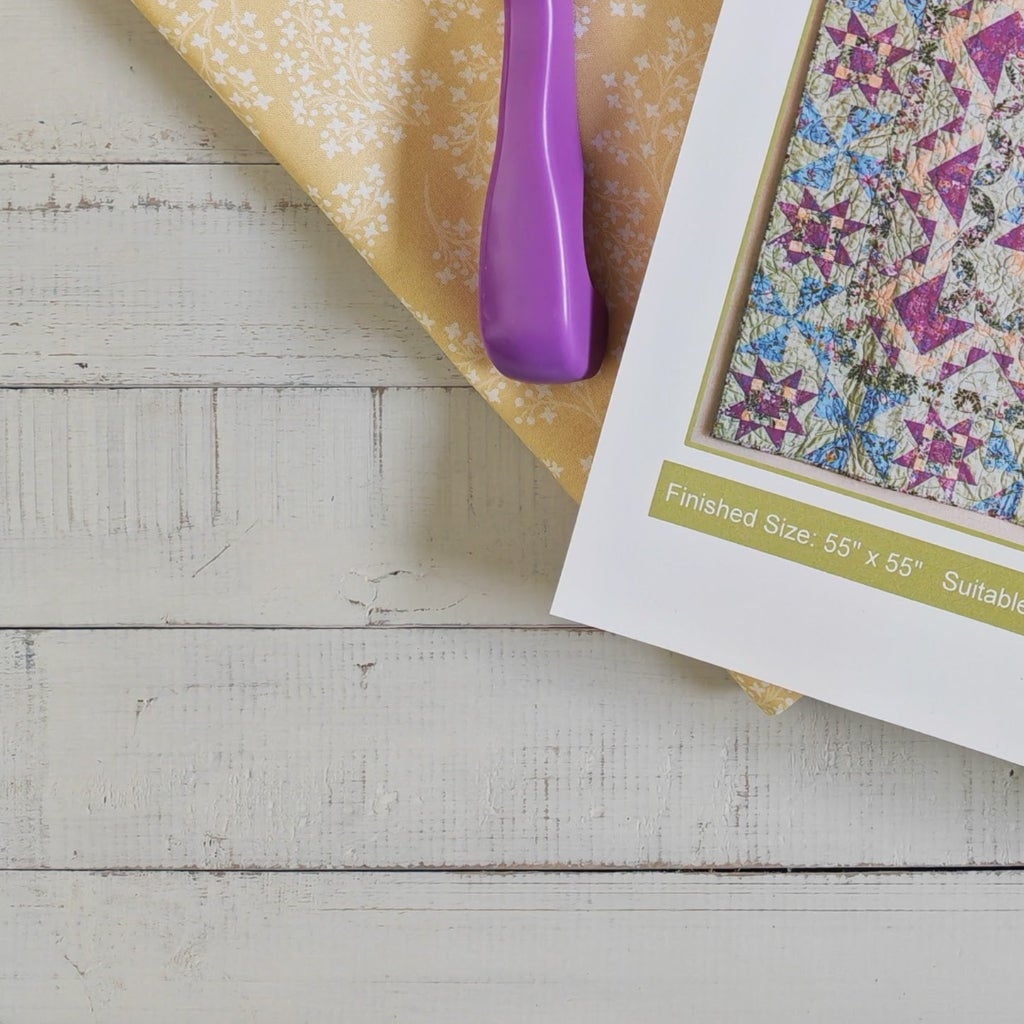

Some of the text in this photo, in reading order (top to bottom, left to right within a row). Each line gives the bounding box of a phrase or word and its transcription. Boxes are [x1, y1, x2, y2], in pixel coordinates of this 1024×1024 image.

[666, 482, 758, 528] Finished
[763, 514, 816, 548] Size:
[824, 532, 862, 558] 55"
[864, 549, 880, 568] x
[885, 552, 923, 577] 55"
